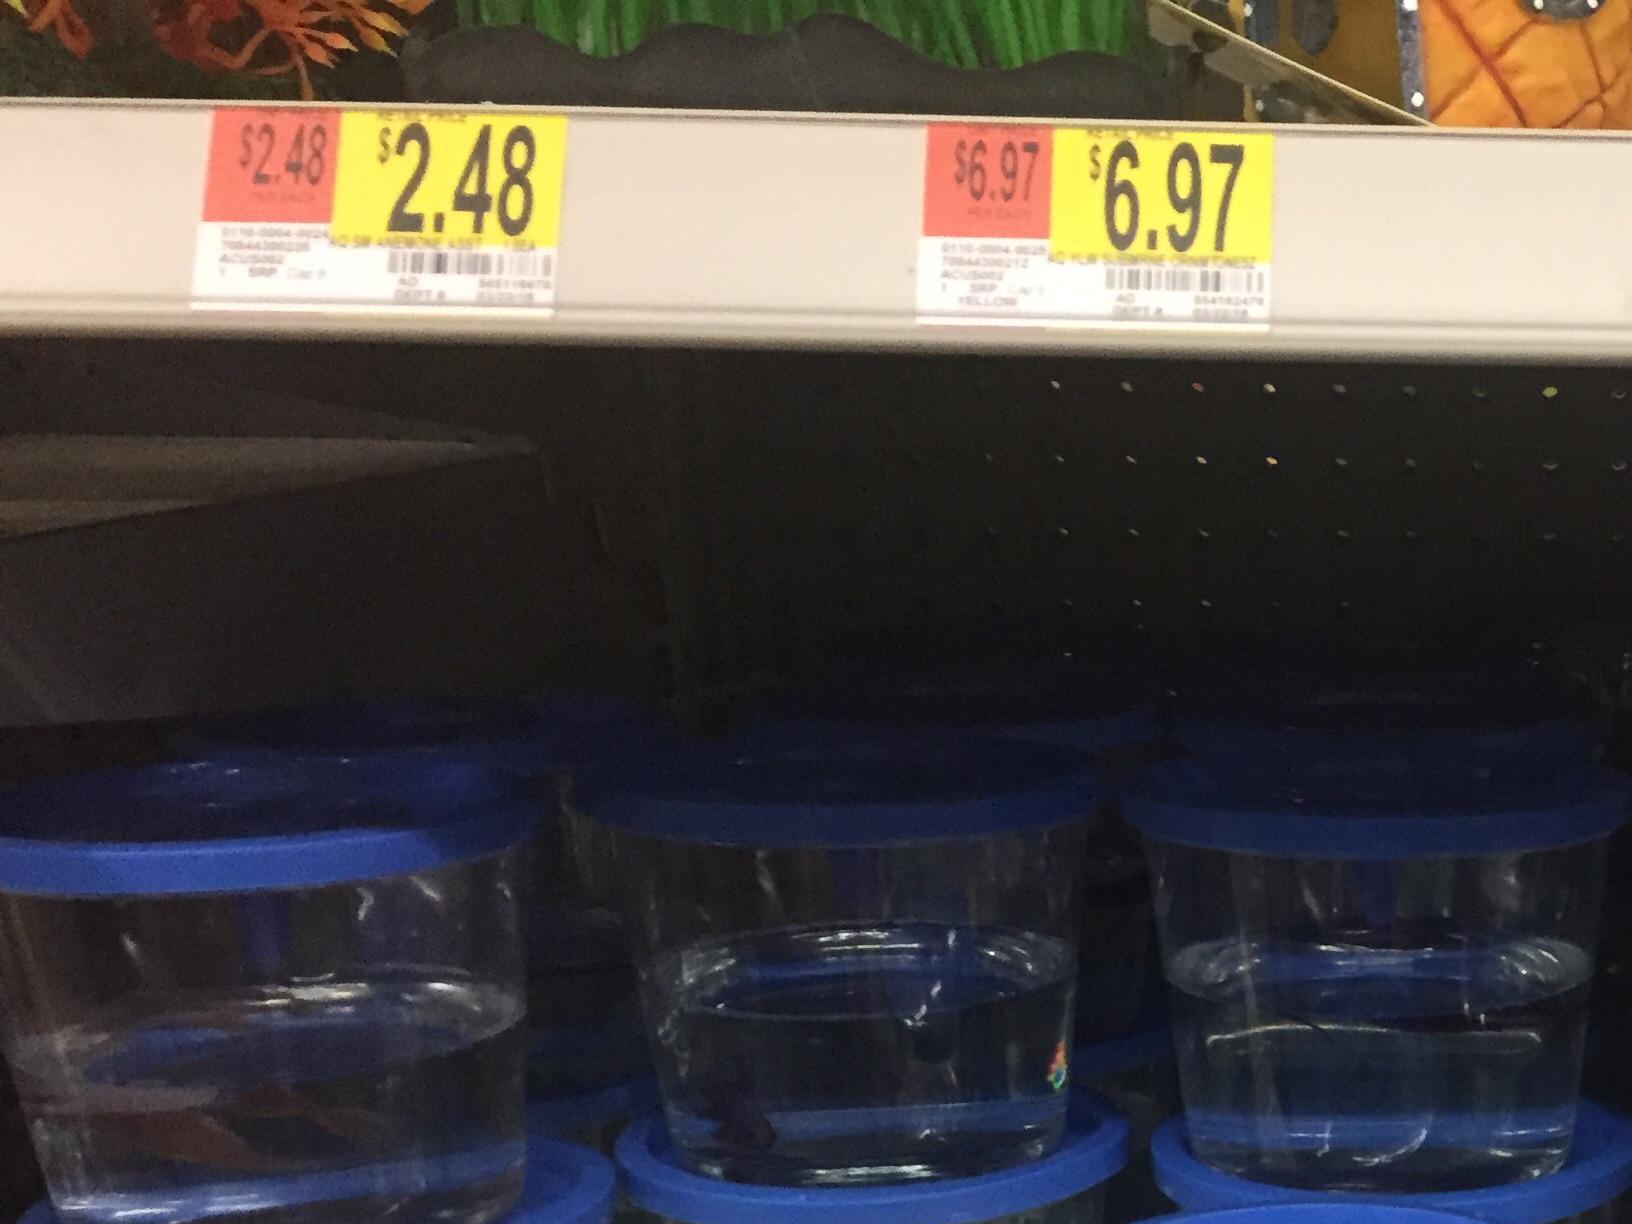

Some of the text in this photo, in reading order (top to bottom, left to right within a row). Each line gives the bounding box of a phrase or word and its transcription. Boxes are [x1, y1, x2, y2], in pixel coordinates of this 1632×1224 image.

[239, 122, 328, 186] $2.48
[377, 122, 536, 237] $2.48
[953, 139, 1040, 203] $6.97
[1088, 140, 1245, 253] $6.97
